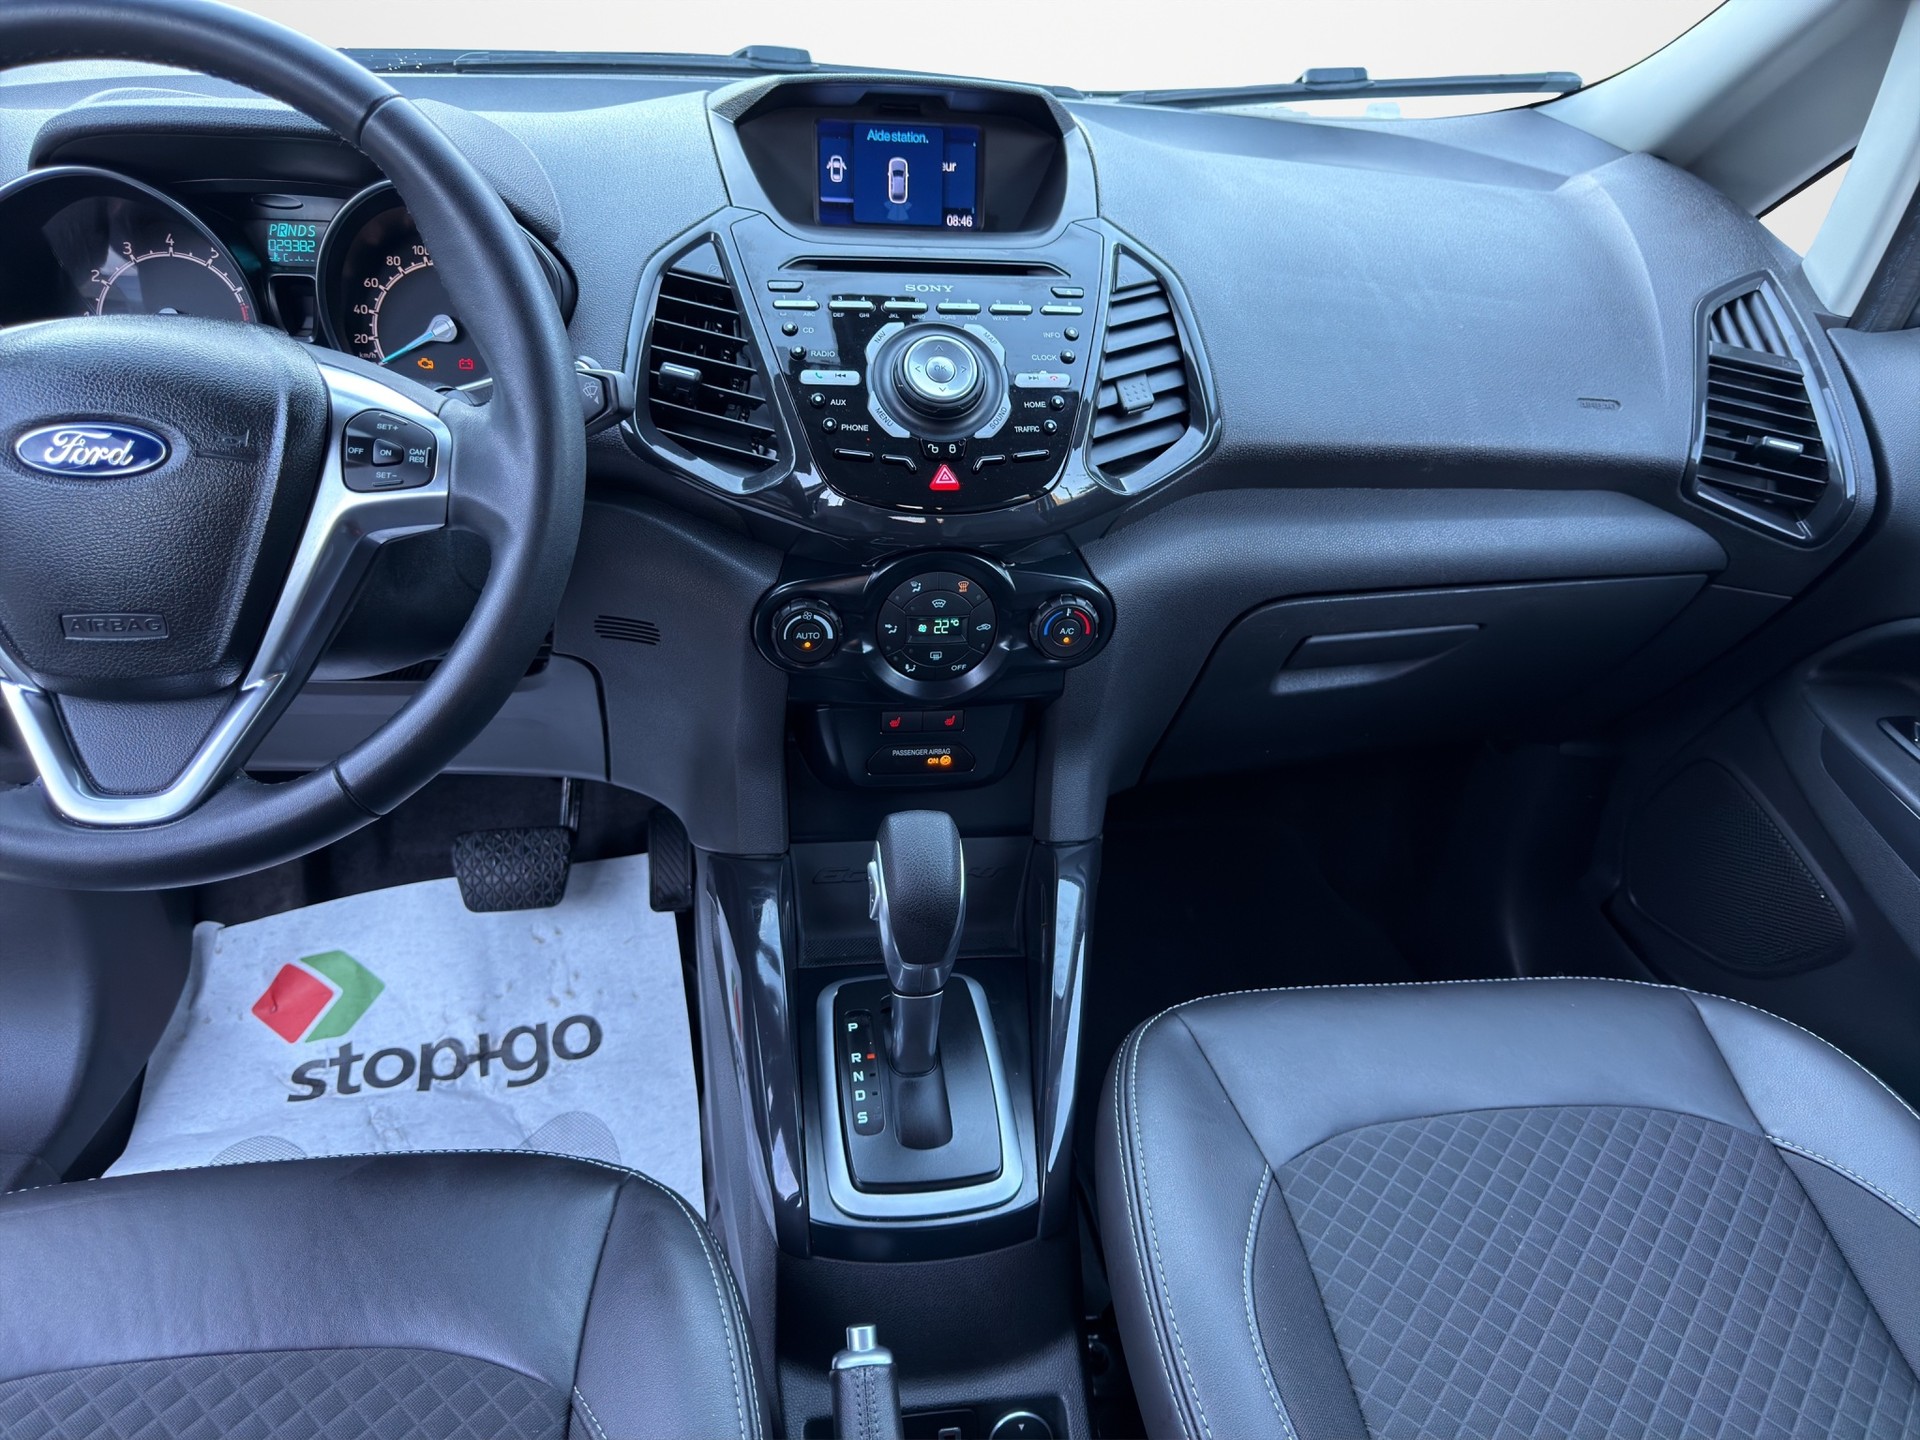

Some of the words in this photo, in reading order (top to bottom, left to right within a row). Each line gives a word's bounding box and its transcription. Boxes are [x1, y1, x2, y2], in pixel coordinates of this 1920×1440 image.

[867, 129, 891, 142] Aide
[891, 131, 929, 144] station.
[947, 215, 973, 227] 08:46
[165, 233, 175, 246] 4
[123, 241, 132, 255] 3
[268, 239, 316, 253] 029382
[386, 256, 401, 266] 80
[91, 269, 100, 282] 2
[363, 278, 379, 288] 60
[905, 284, 954, 293] SONY
[353, 305, 368, 315] 40
[354, 333, 369, 344] 20
[874, 331, 886, 344] NAV
[983, 331, 998, 346] MAP
[359, 351, 377, 359] km/h
[934, 364, 947, 372] OK
[875, 407, 894, 428] MENU
[989, 406, 1008, 430] SOUND
[841, 424, 869, 432] PHONE
[44, 430, 136, 466] Ford
[348, 447, 365, 455] OFF
[409, 448, 426, 456] CAN
[70, 618, 162, 633] AIRBAG
[1059, 627, 1075, 635] A/C
[795, 631, 820, 640] AUTO
[950, 664, 967, 672] OFF
[847, 1023, 859, 1032] P
[286, 1014, 604, 1103] stop+go
[851, 1053, 862, 1063] R
[853, 1070, 864, 1082] N
[855, 1090, 866, 1101] D
[857, 1112, 868, 1124] S
